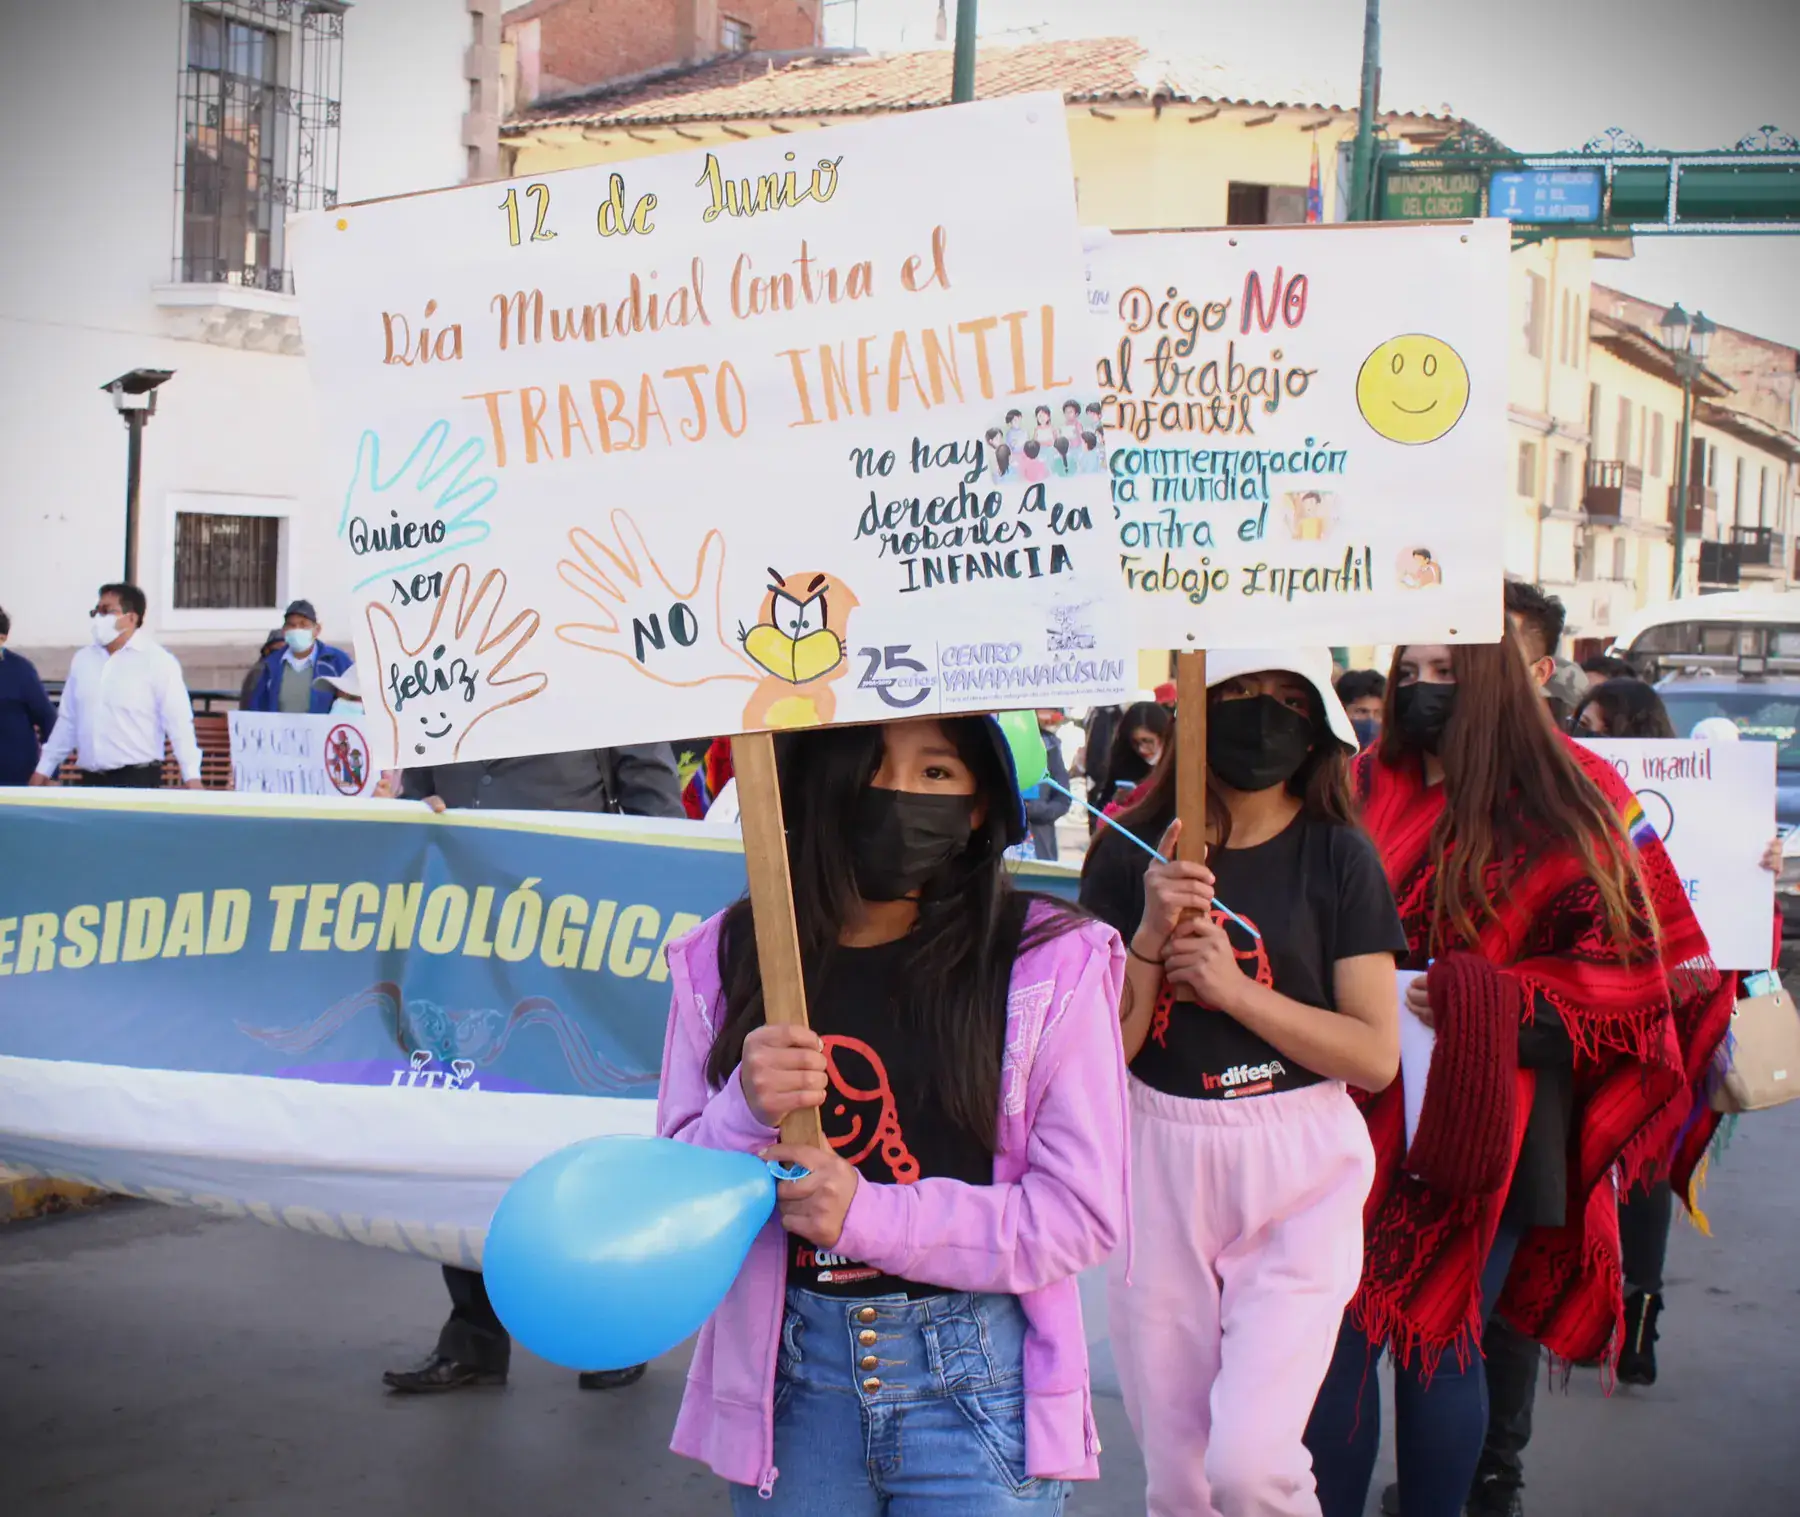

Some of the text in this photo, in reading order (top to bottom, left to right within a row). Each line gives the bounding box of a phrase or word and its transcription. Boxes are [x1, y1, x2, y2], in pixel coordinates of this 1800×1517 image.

[498, 152, 843, 246] 12 de Junio
[1402, 197, 1423, 216] DEL
[382, 224, 952, 367] Día Mundial Contra el
[1118, 265, 1309, 358] Digo NO
[461, 305, 1074, 467] TRABAJO INFANTIL
[1096, 336, 1318, 413] al trabajo
[849, 436, 988, 484] no hay
[1151, 468, 1271, 502] mundial
[349, 510, 446, 556] Quiero
[854, 481, 1047, 541] derecho a
[878, 502, 1093, 558] robarles la
[1112, 501, 1269, 548] ontra el
[390, 570, 443, 606] ser
[899, 544, 1074, 593] INFANCIA
[633, 602, 698, 663] NO
[941, 640, 1023, 668] CENTRO
[388, 644, 479, 712] feliz
[857, 644, 931, 709] 25
